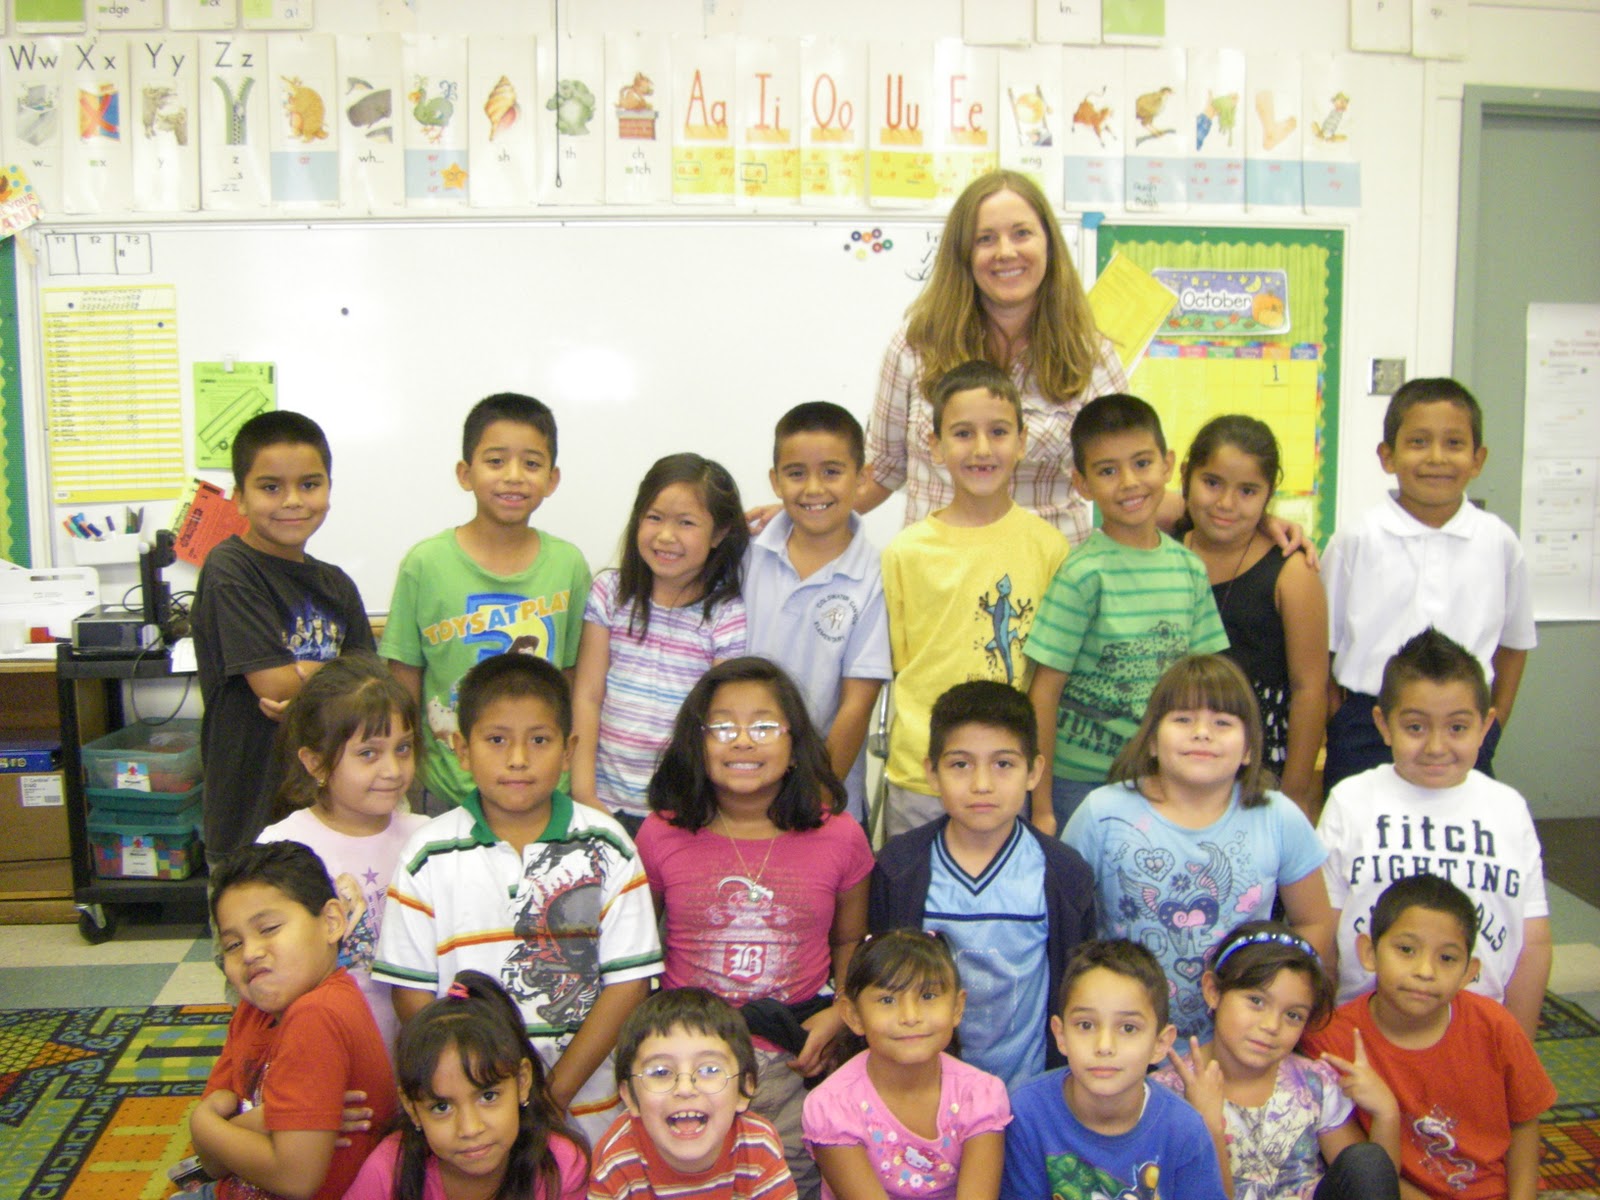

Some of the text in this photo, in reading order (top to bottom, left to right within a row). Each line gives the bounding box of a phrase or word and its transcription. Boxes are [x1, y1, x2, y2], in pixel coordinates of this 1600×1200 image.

[109, 1, 130, 18] dge
[685, 68, 727, 129] Aa
[498, 150, 510, 162] sh
[565, 148, 577, 160] th
[632, 149, 645, 160] ch
[90, 235, 102, 245] T2
[125, 235, 141, 246] T3
[1182, 290, 1252, 310] October
[422, 612, 486, 646] TOYS
[487, 603, 521, 630] AT
[1375, 814, 1497, 858] fitch
[1350, 854, 1521, 899] FIGHTING
